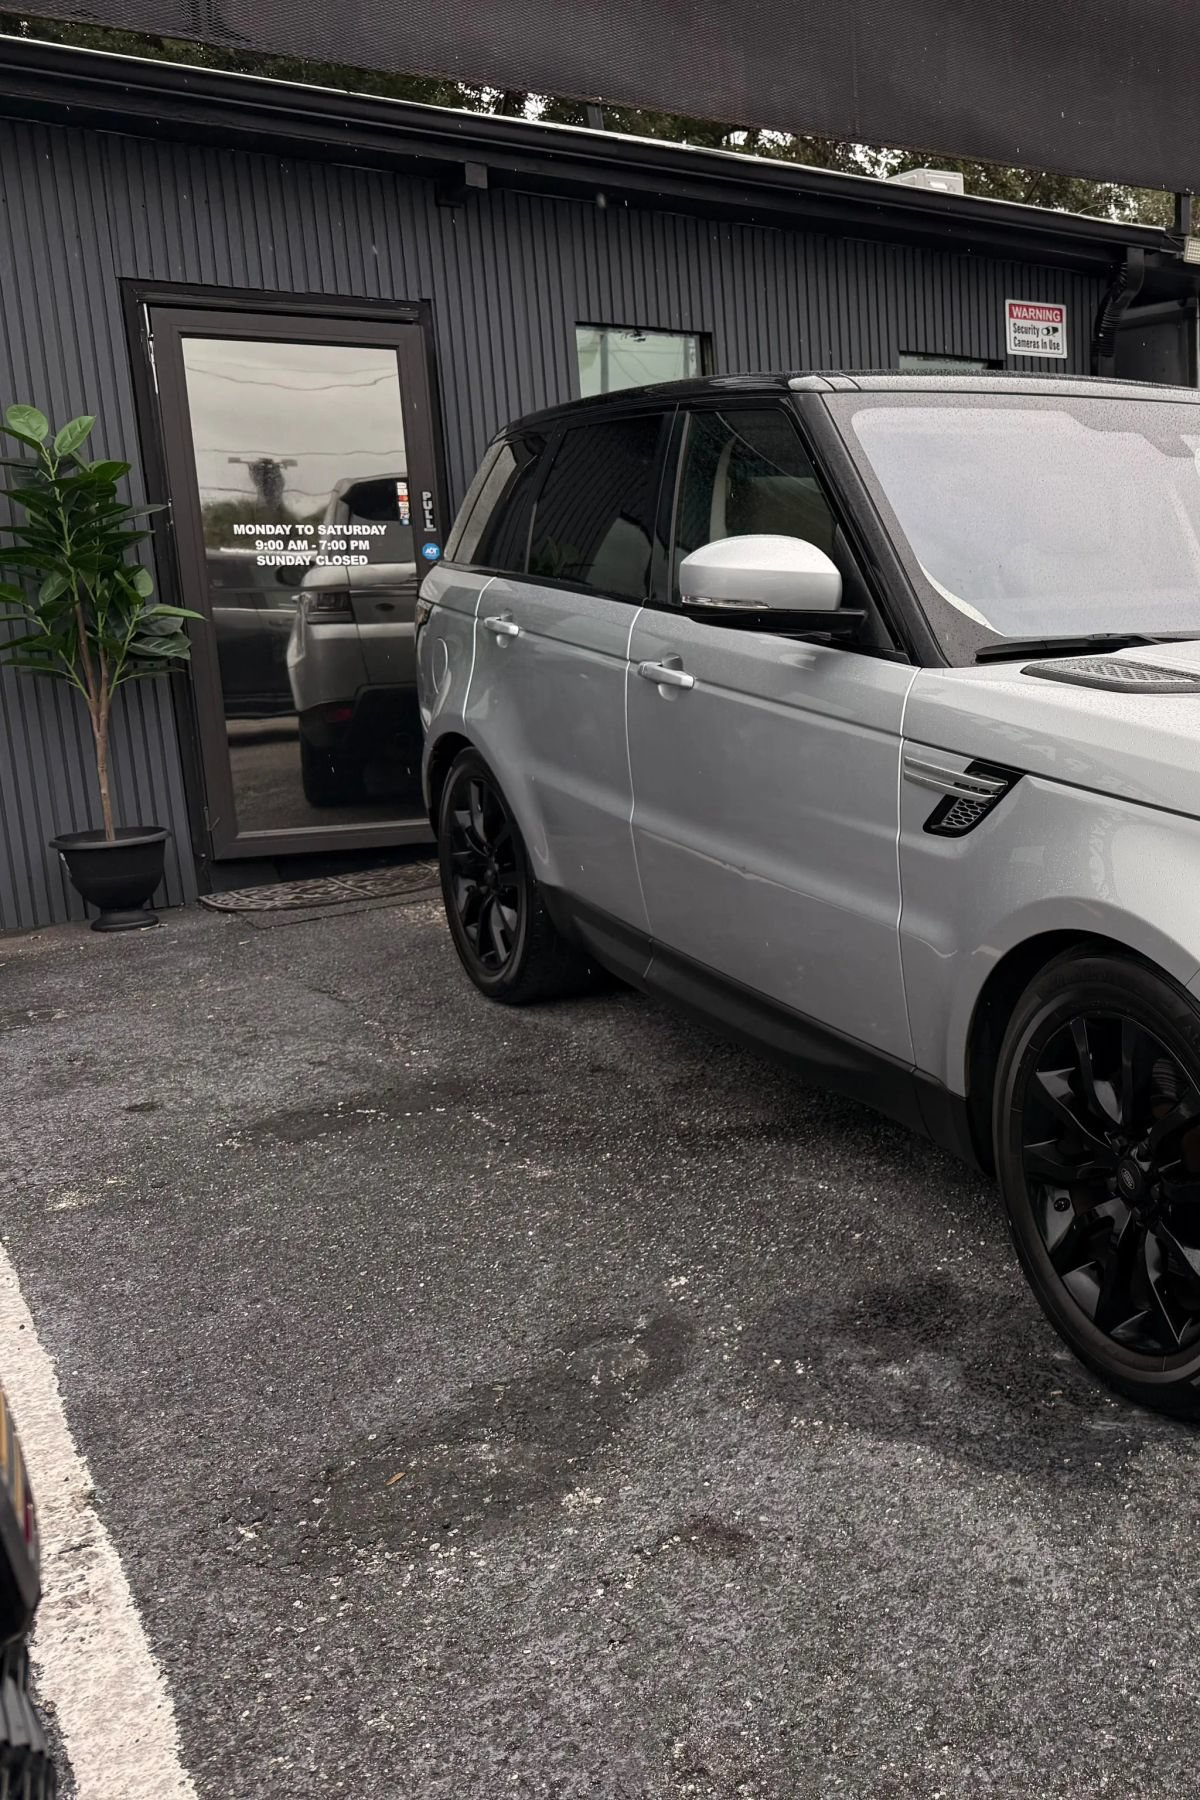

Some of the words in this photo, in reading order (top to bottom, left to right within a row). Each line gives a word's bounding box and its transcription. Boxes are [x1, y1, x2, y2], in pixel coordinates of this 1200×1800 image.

[1012, 306, 1060, 321] WARNING
[1013, 323, 1039, 337] Security
[1013, 336, 1039, 349] Cameras
[1041, 339, 1047, 349] In
[1048, 339, 1061, 351] Use
[421, 491, 434, 529] PULL
[233, 524, 292, 535] MONDAY
[295, 524, 315, 535] TO
[317, 524, 387, 535] SATURDAY
[255, 540, 284, 550] 9:00
[287, 540, 309, 550] AM
[319, 540, 346, 550] 7:00
[350, 540, 370, 550] PM
[256, 555, 311, 566] SUNDAY
[315, 555, 369, 566] CLOSED
